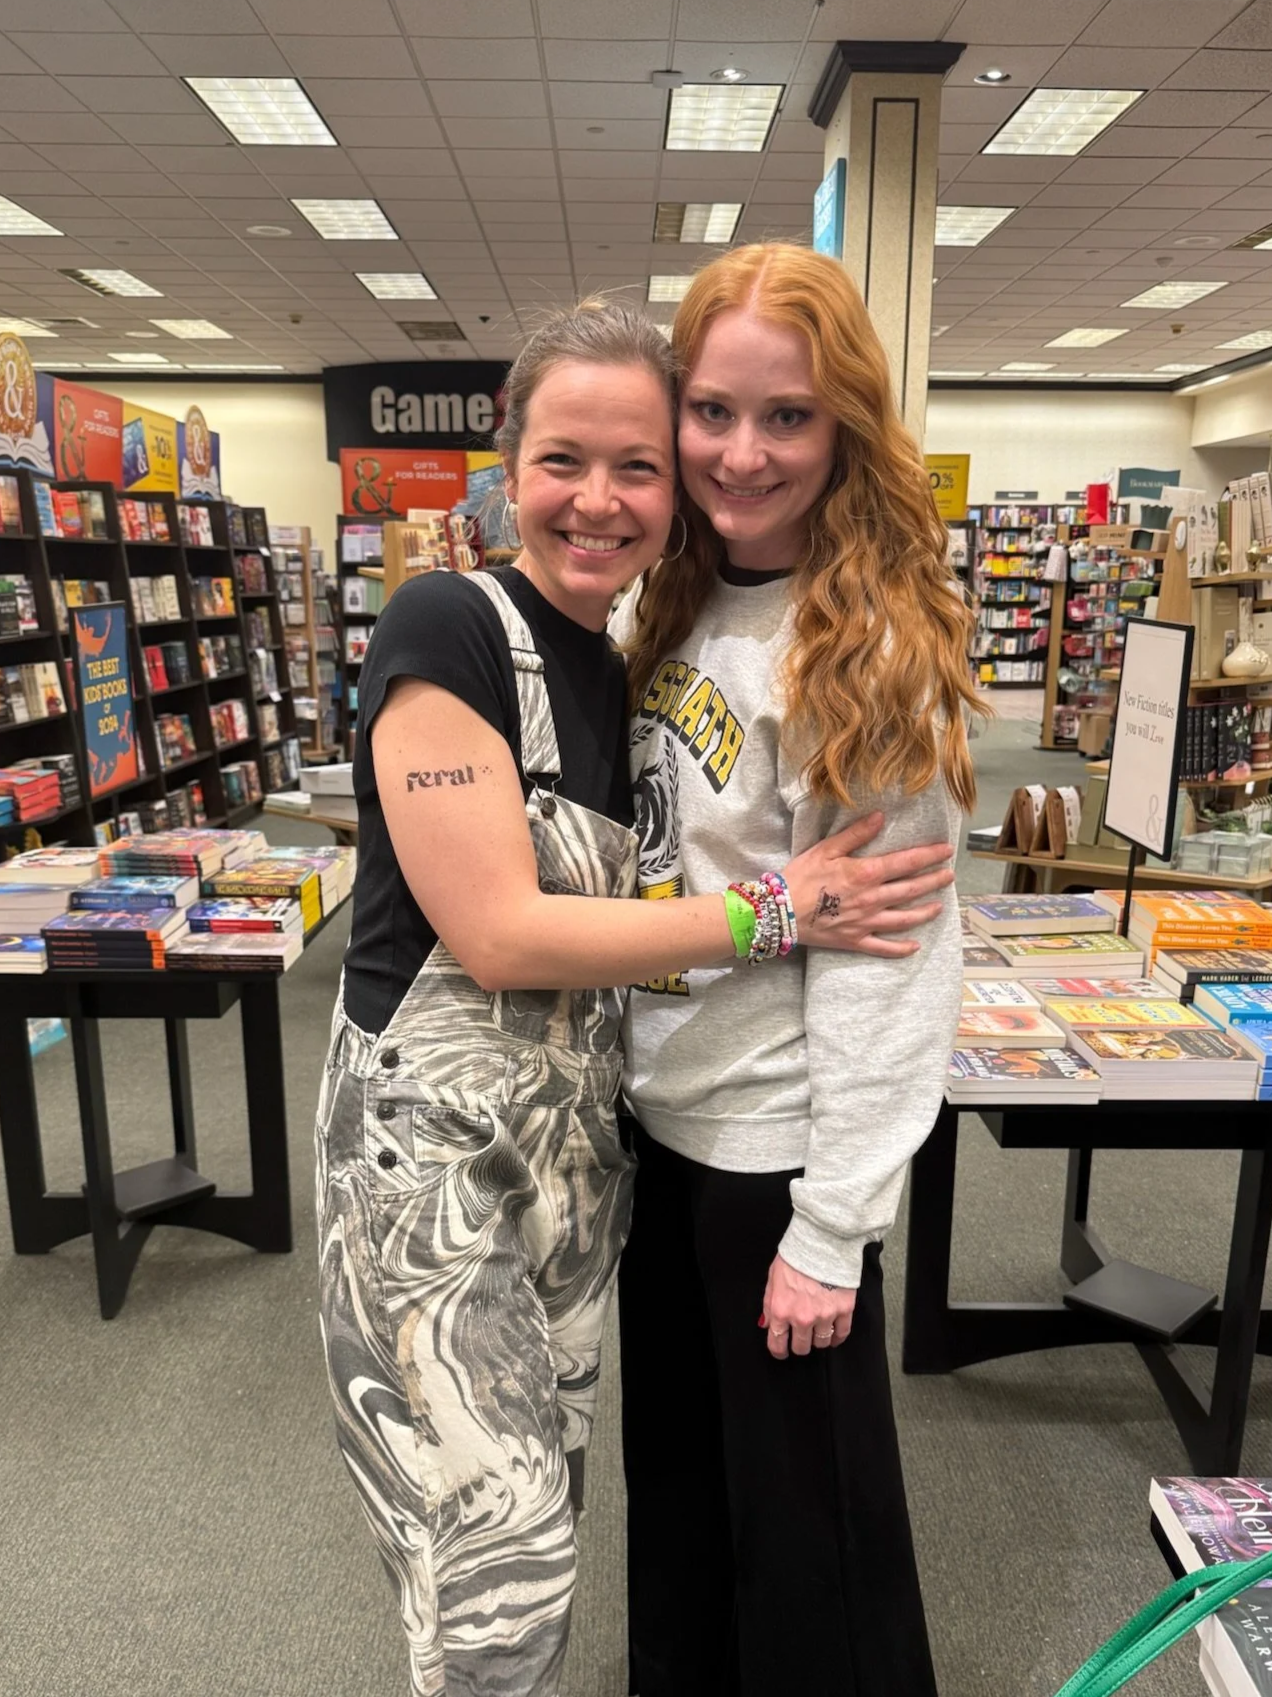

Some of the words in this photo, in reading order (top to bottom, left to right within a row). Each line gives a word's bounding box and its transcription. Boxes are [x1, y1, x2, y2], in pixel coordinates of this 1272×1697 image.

[370, 385, 506, 434] Game
[394, 471, 414, 479] FOR
[415, 472, 458, 480] READERS
[412, 462, 439, 470] GIFTS
[86, 662, 102, 680] THE
[102, 658, 120, 676] BEST
[102, 679, 127, 699] BOOKS
[1124, 690, 1136, 706] New
[1137, 694, 1157, 714] Fiction
[1158, 701, 1175, 719] titles
[639, 660, 745, 794] SGIATH
[1125, 722, 1137, 736] you
[1138, 724, 1149, 739] will
[1197, 1528, 1225, 1565] HOWA
[1248, 1604, 1272, 1641] ALE
